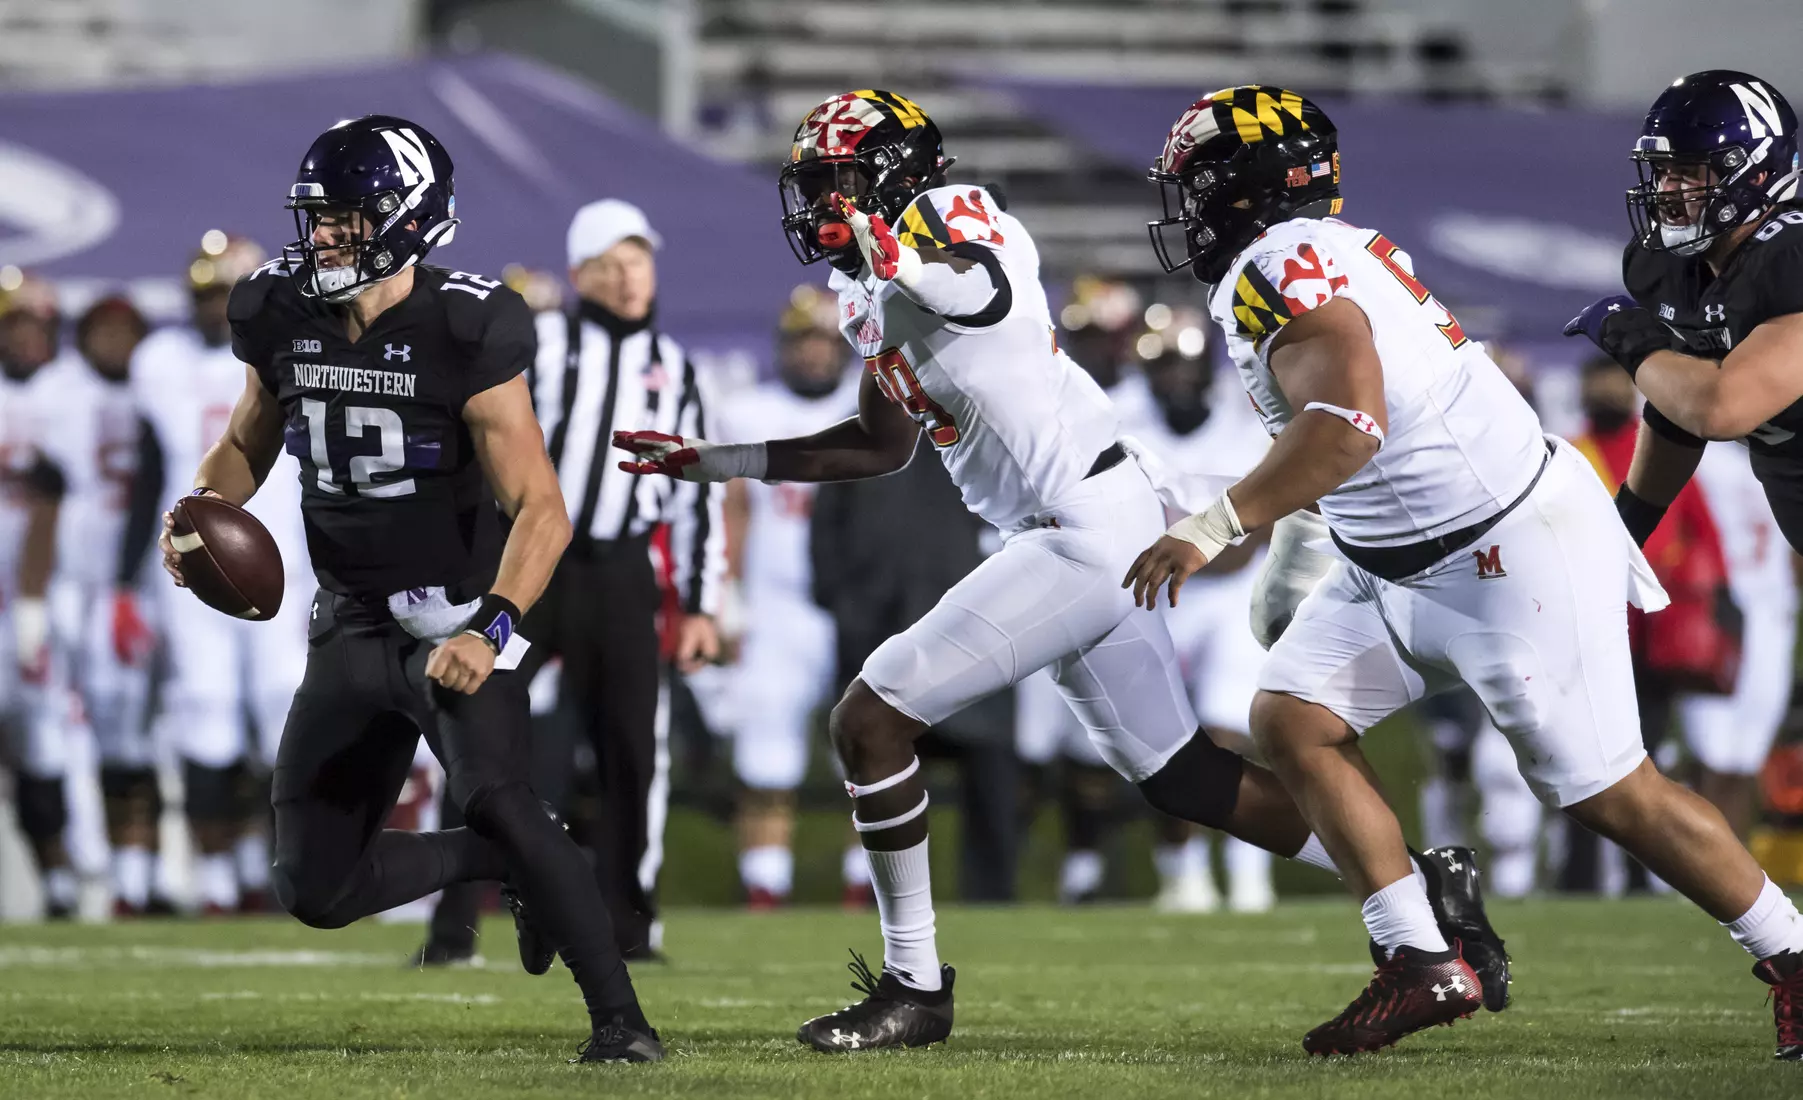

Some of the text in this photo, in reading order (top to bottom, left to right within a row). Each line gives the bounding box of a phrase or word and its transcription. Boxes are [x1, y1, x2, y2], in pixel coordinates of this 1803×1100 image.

[1729, 81, 1784, 139] N
[380, 128, 436, 187] N
[440, 271, 502, 300] 12
[293, 363, 416, 397] NORTHWESTERN
[301, 397, 416, 498] 12
[1472, 545, 1507, 579] M
